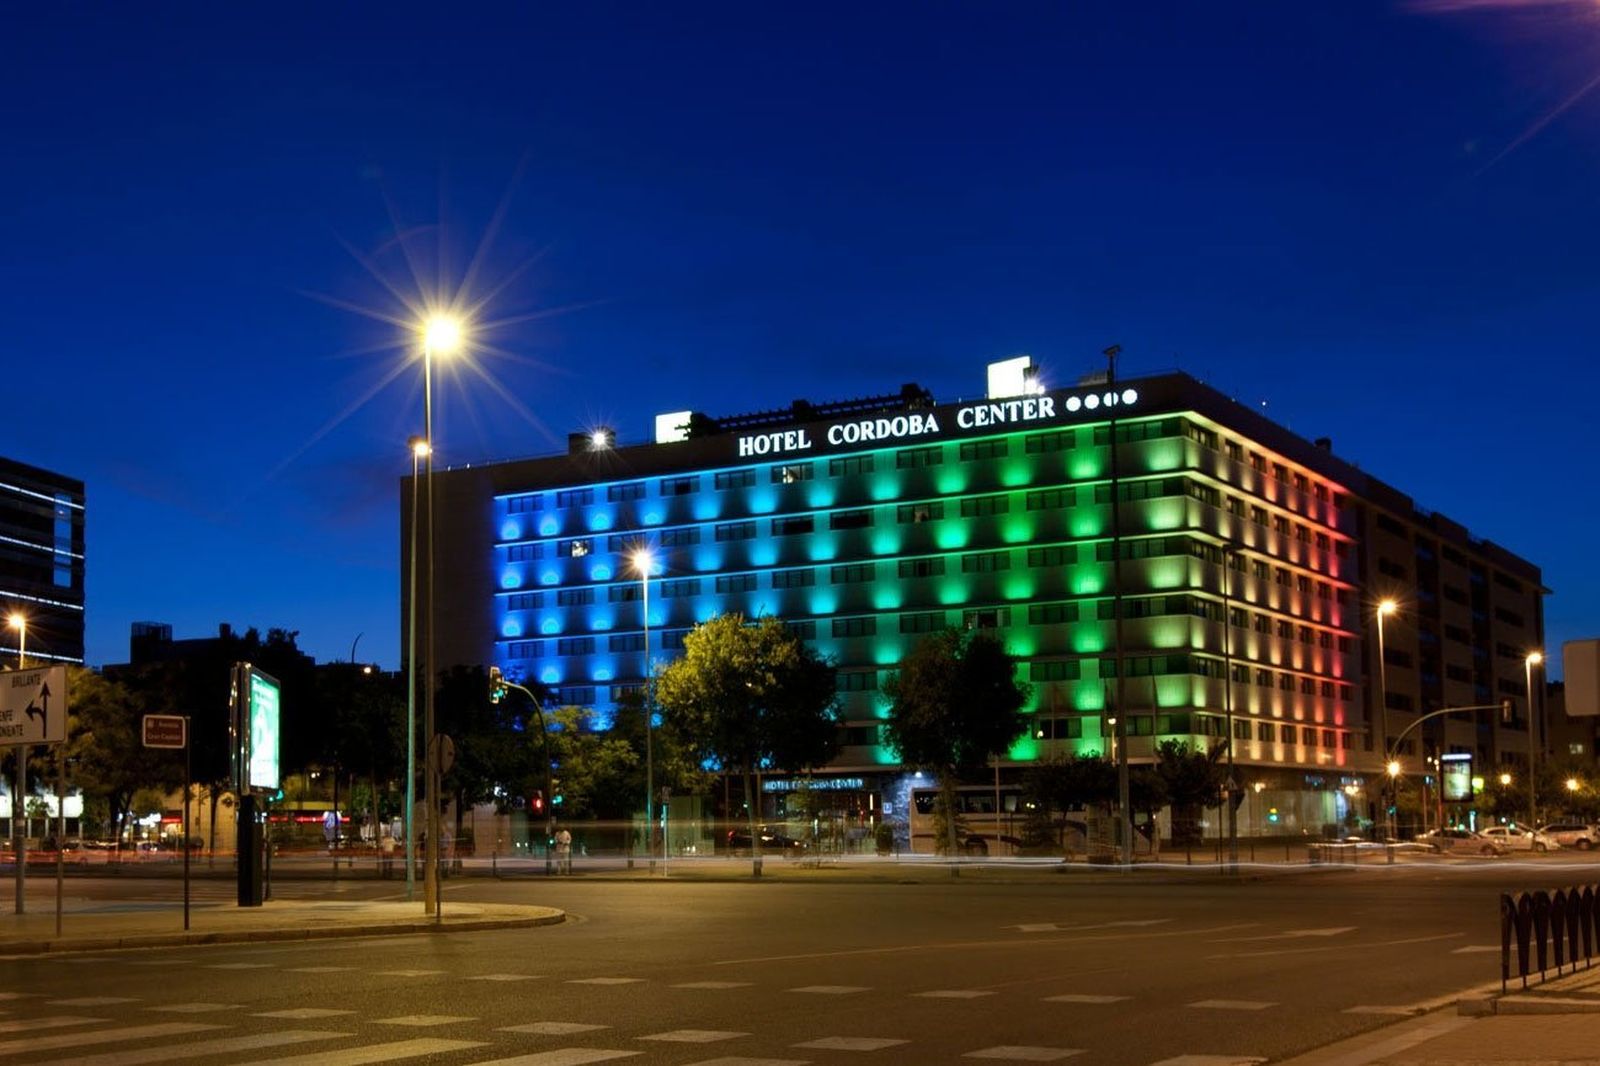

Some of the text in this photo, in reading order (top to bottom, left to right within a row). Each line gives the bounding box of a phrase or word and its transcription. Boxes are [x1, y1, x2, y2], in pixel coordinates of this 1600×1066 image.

[738, 397, 1056, 457] HOTEL CORDOBA CENTER
